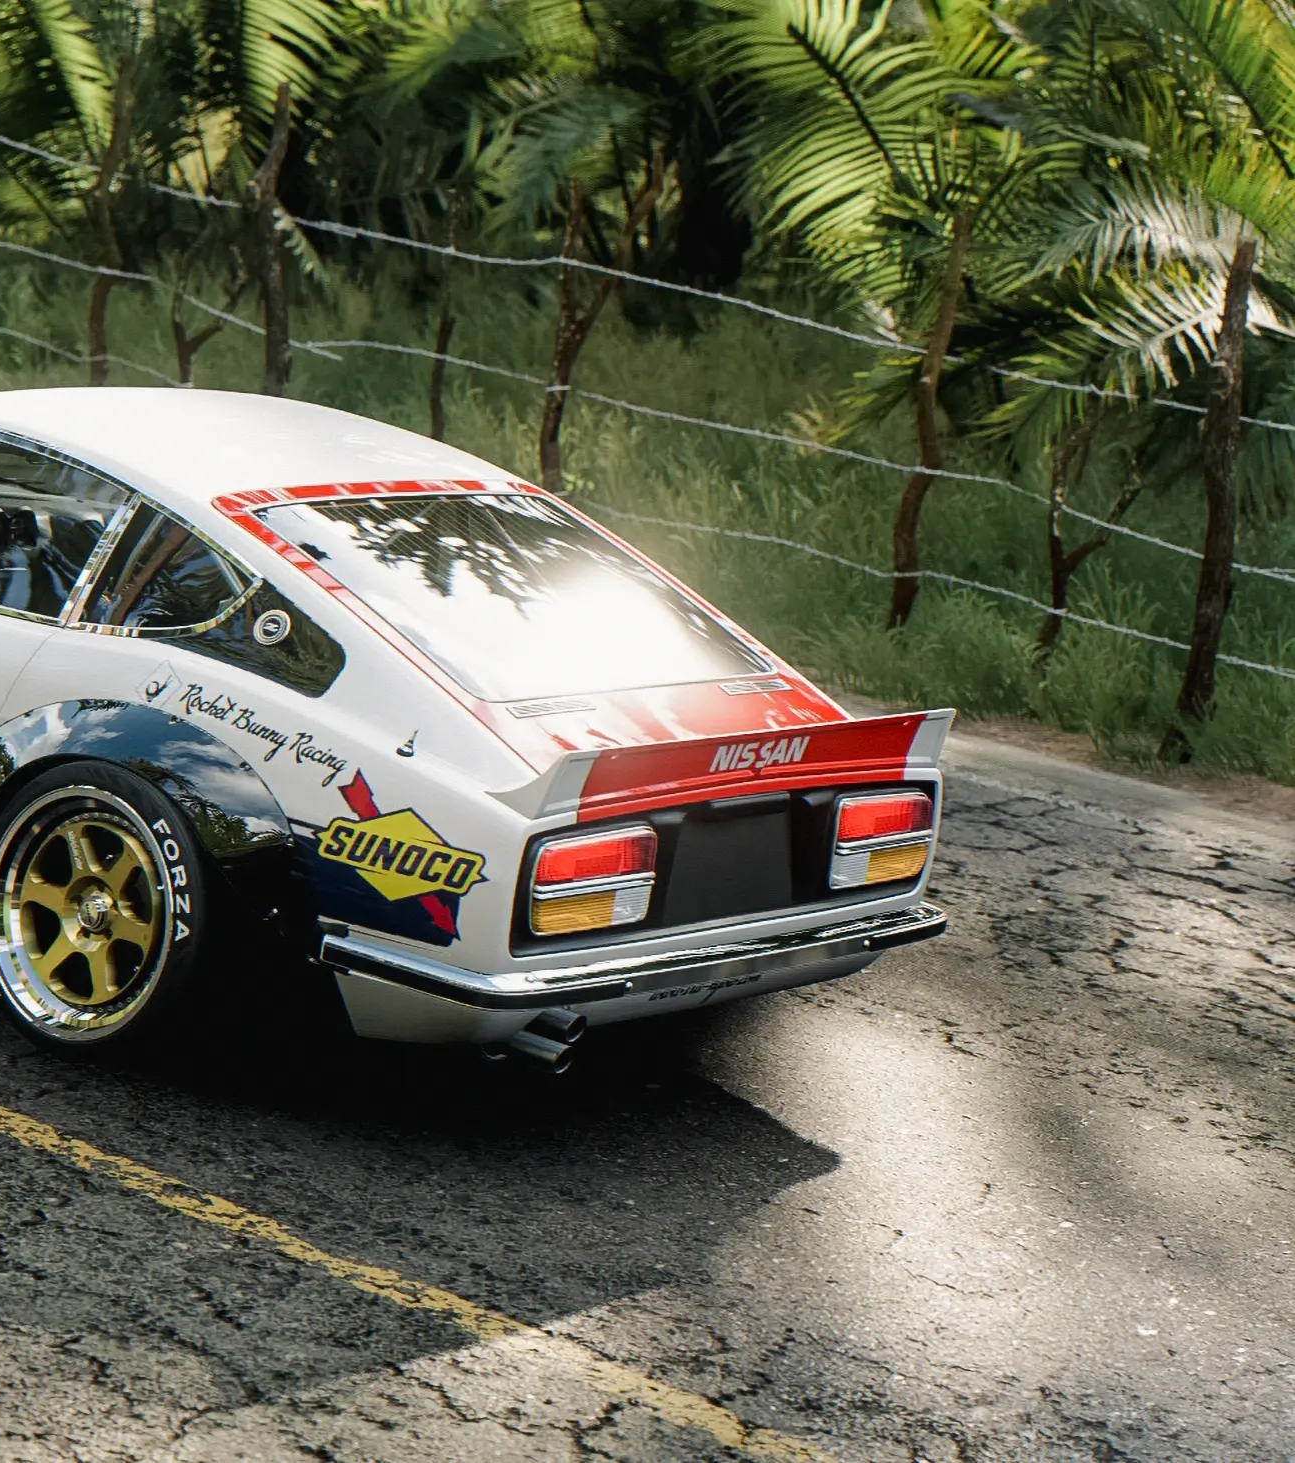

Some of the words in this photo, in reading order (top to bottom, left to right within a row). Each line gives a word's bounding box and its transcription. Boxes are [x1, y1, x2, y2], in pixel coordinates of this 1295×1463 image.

[179, 683, 238, 722] Rocket
[230, 708, 289, 762] Bunny
[288, 732, 348, 787] Racing
[708, 736, 811, 774] NISSAN
[152, 818, 192, 942] FORZA
[323, 825, 478, 889] SUNOCO
